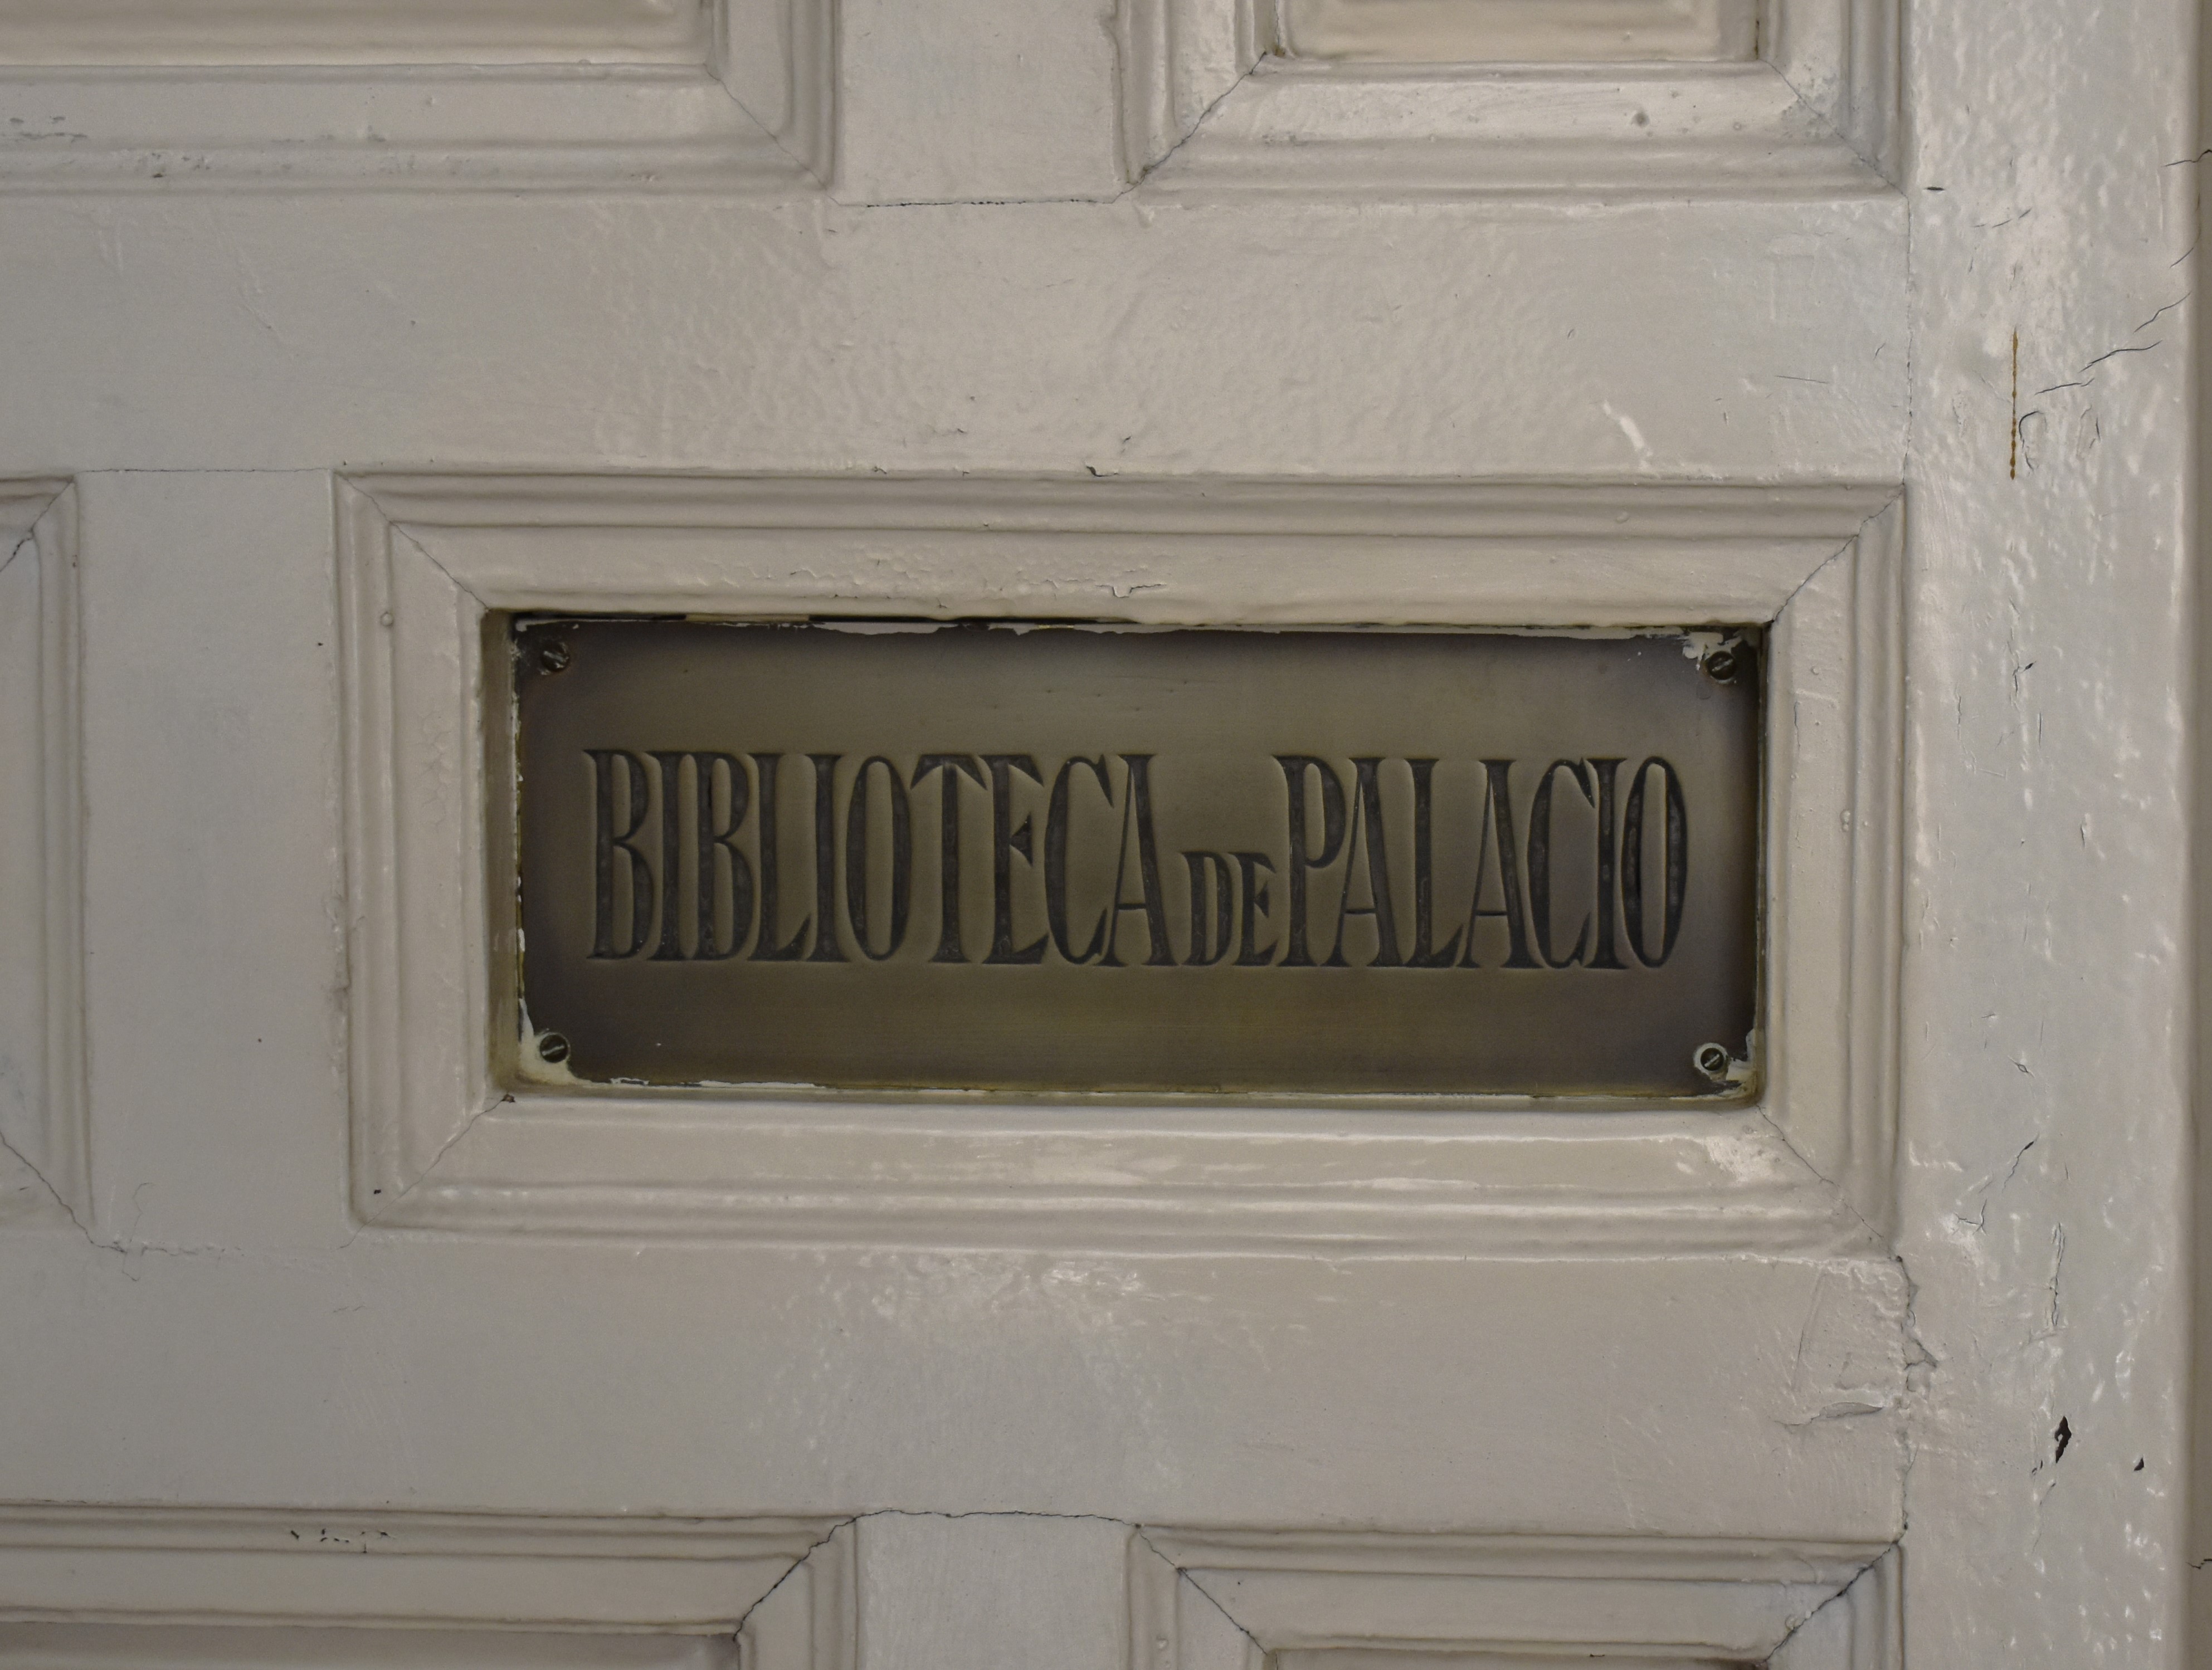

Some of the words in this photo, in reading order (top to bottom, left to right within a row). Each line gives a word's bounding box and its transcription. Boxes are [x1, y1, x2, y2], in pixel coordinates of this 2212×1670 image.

[583, 749, 1176, 967] BIBLIOTECA
[1180, 852, 1277, 965] DE
[1273, 755, 1688, 969] PALACIO
